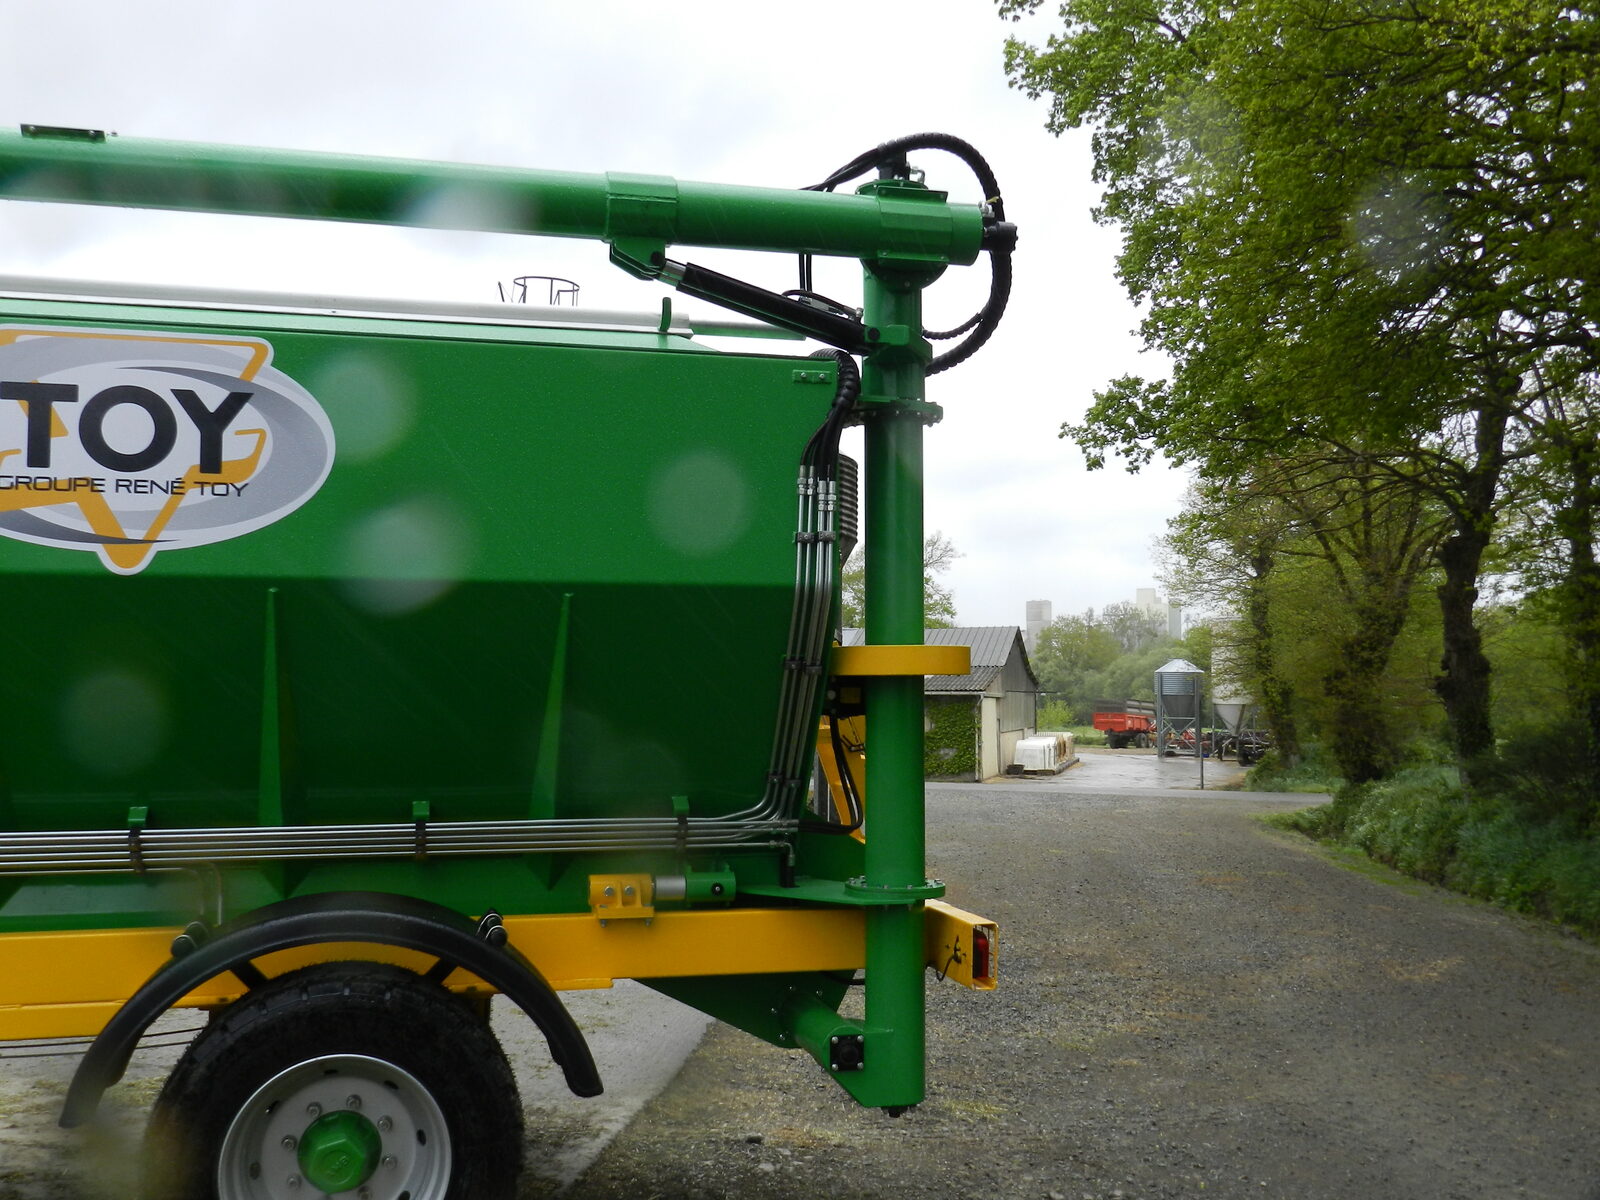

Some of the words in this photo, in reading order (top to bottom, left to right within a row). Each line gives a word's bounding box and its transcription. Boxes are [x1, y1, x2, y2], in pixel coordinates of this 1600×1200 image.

[0, 381, 254, 474] TOY
[0, 475, 106, 493] GROUPE
[115, 477, 186, 495] RENÉ
[193, 481, 249, 497] TOY
